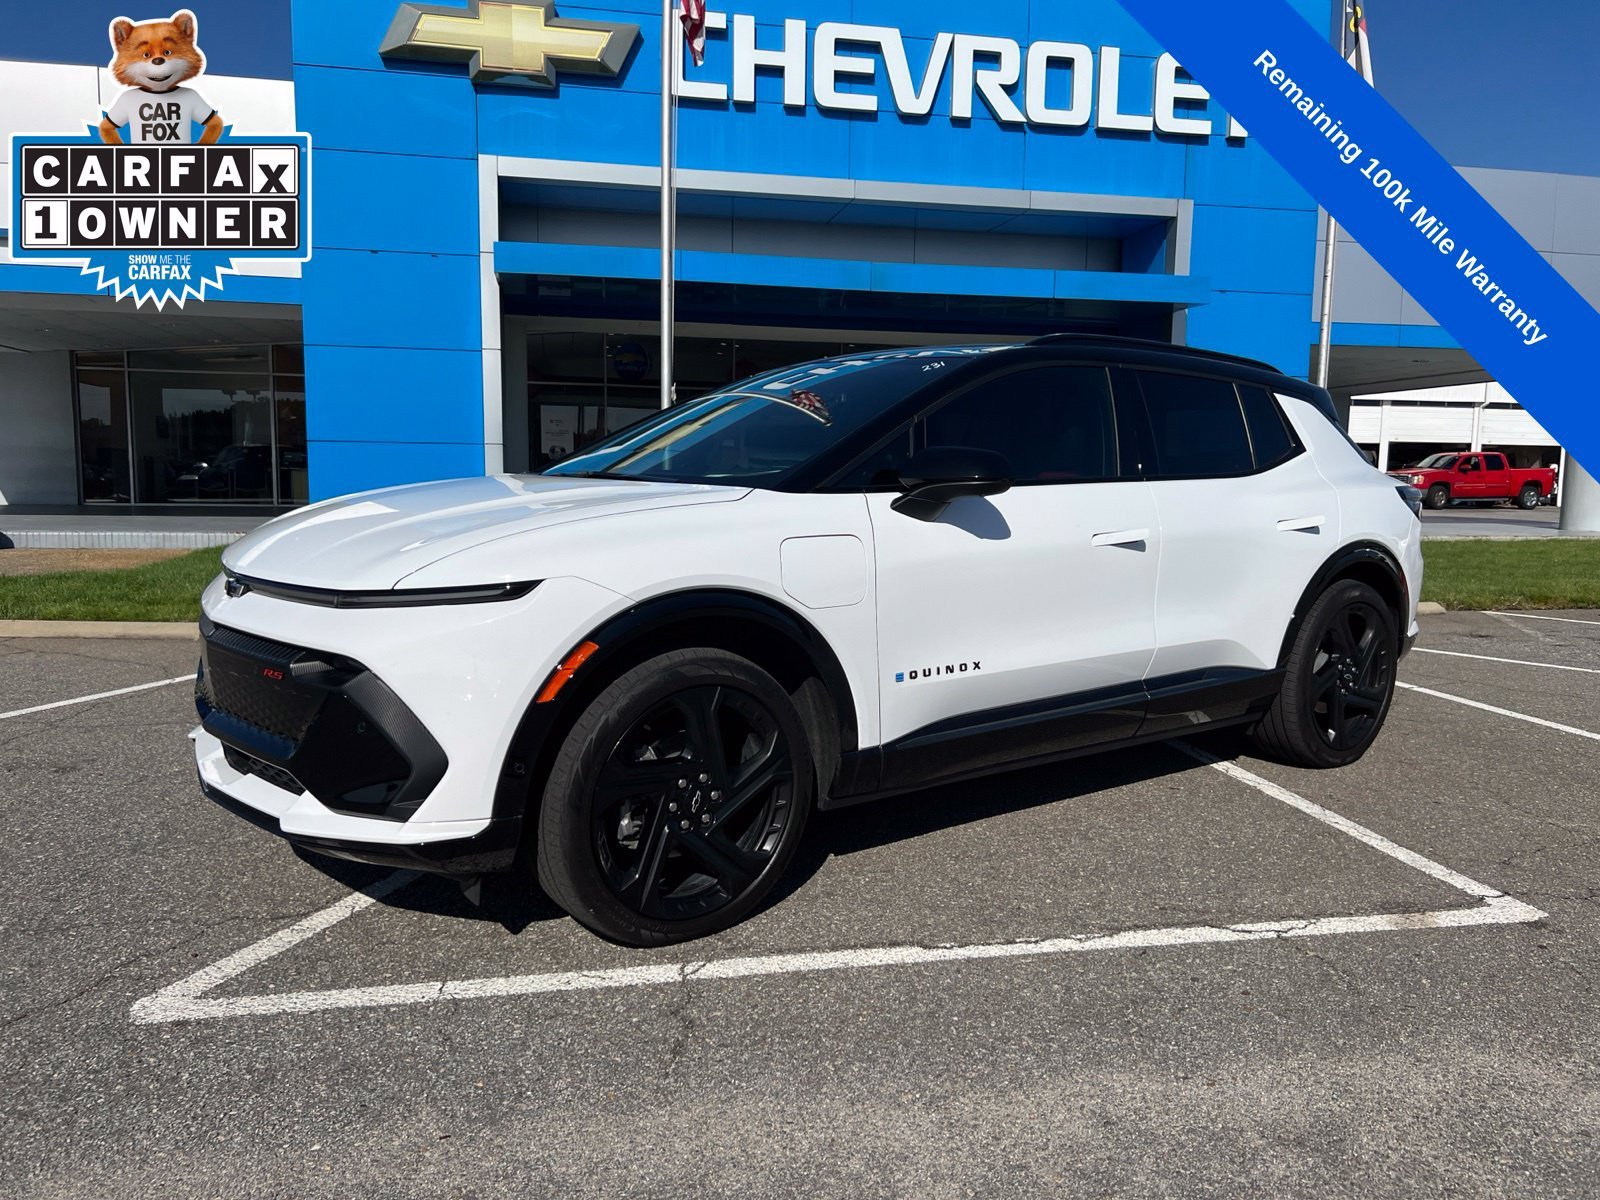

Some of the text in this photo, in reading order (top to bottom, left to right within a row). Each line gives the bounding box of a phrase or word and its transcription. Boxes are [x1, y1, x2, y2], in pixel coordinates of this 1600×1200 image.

[672, 9, 1248, 137] CHEVROLE
[921, 361, 945, 371] 231
[263, 669, 283, 680] RS
